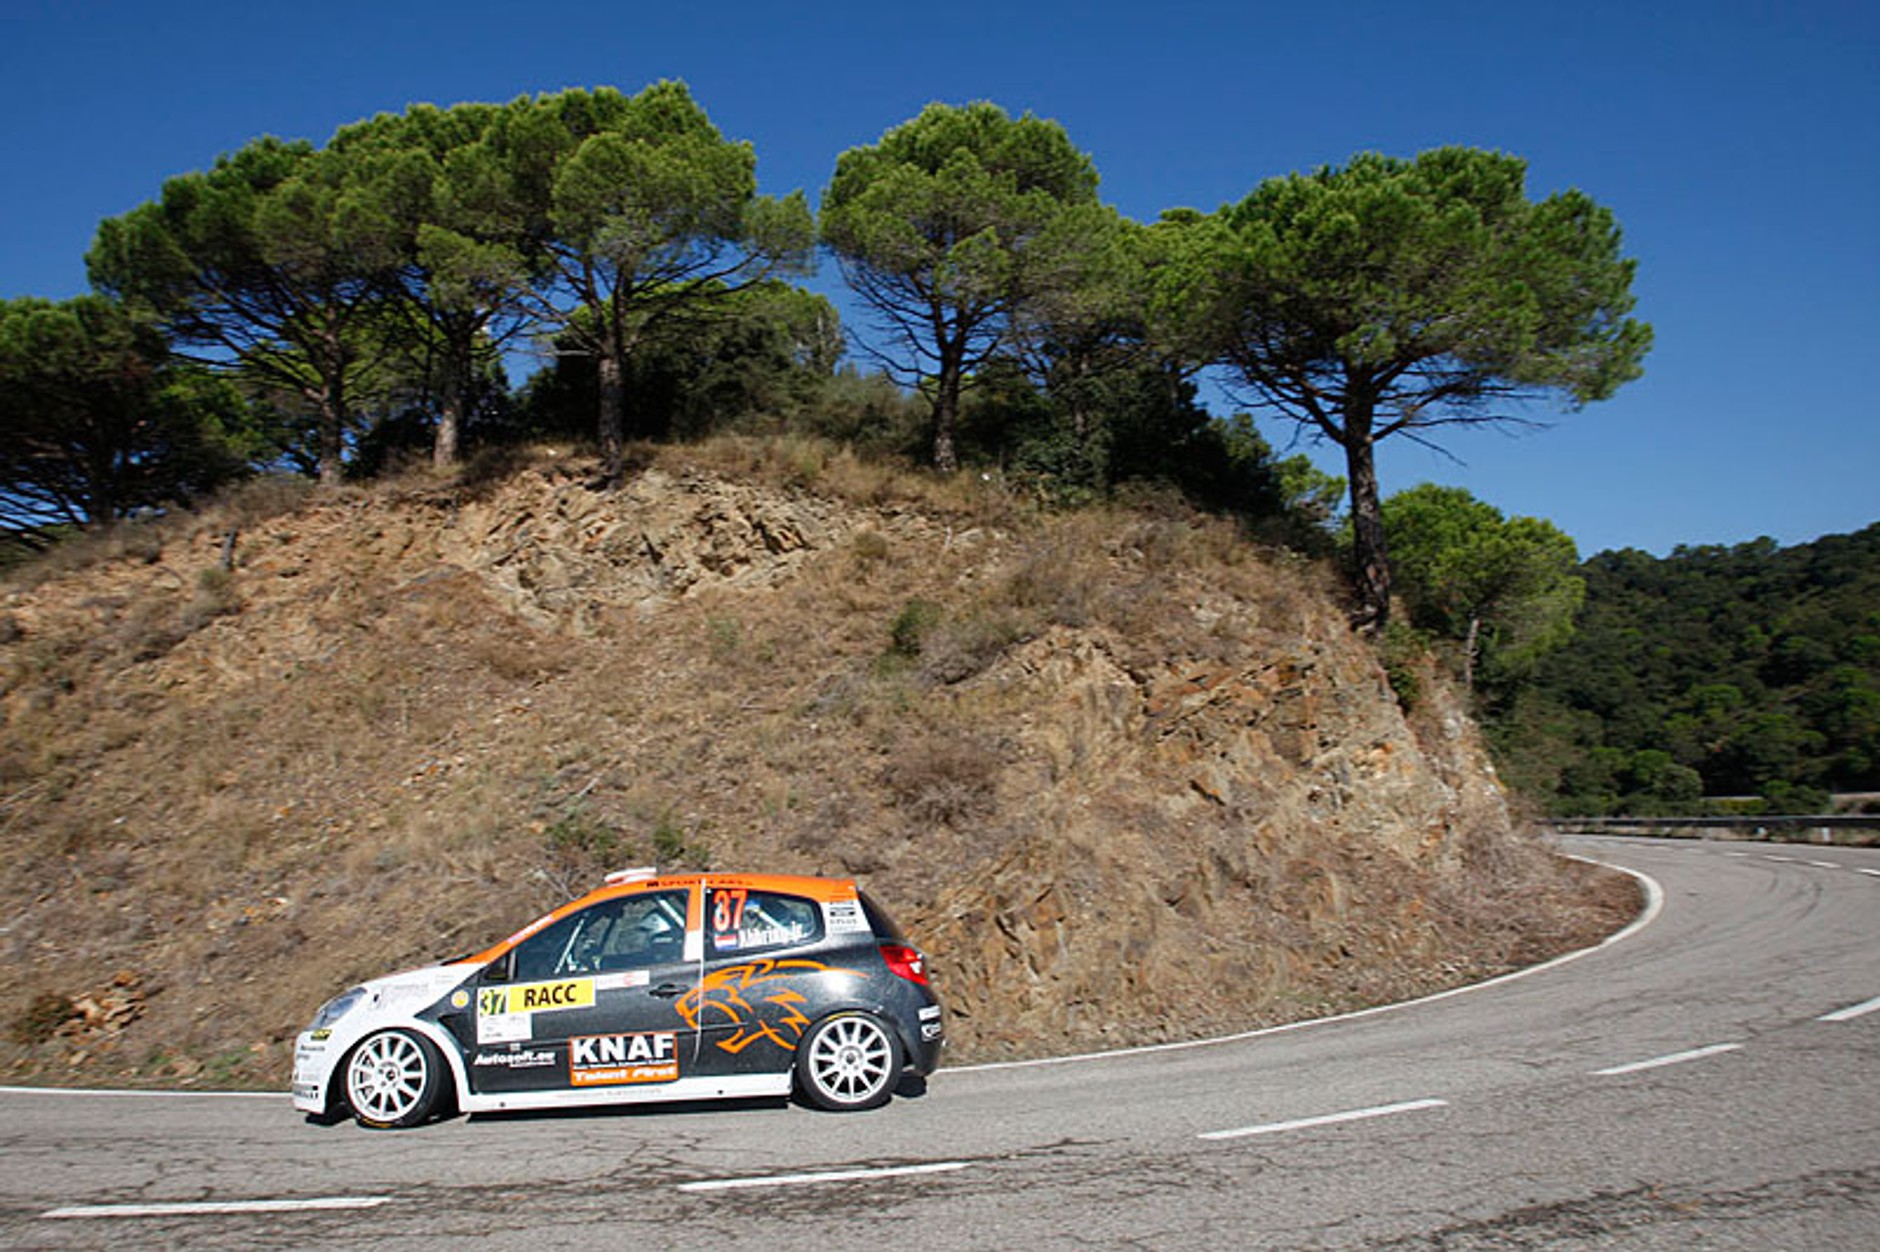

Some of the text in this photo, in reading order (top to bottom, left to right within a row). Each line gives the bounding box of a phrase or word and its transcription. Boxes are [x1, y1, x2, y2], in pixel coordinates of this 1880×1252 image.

[713, 889, 748, 932] 37
[480, 989, 507, 1017] 37
[524, 984, 577, 1008] RACC
[573, 1034, 675, 1064] KNAF
